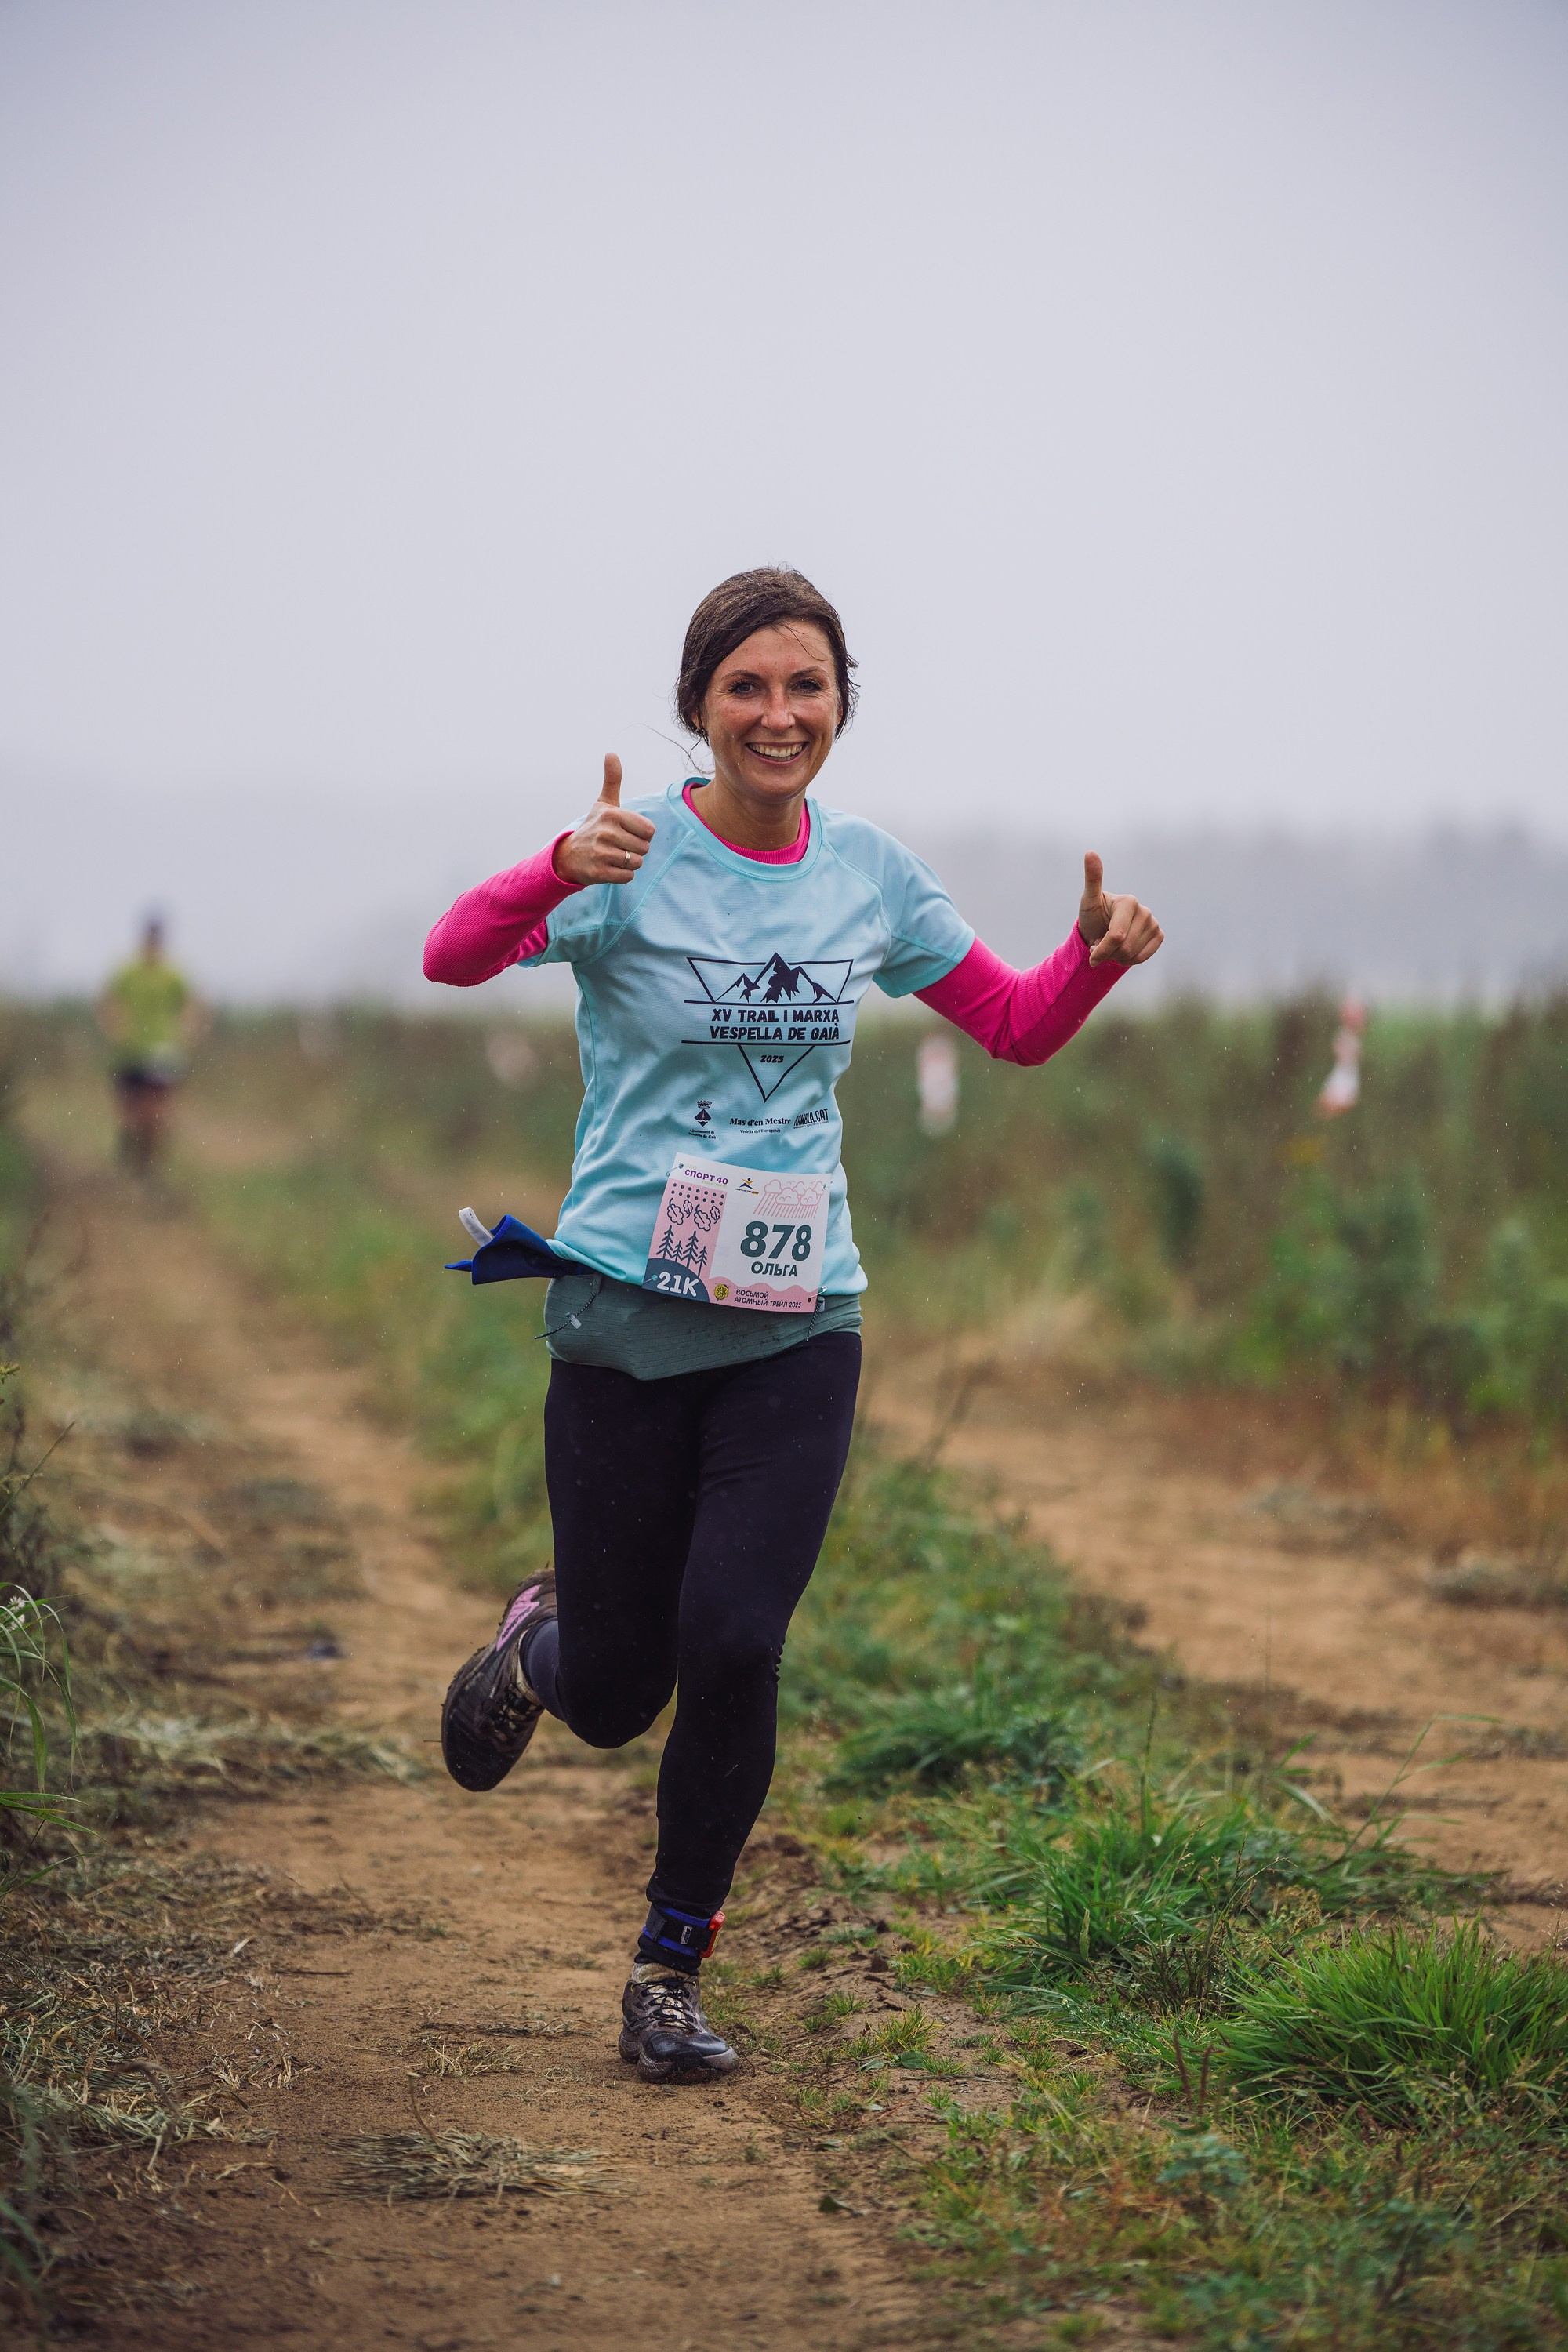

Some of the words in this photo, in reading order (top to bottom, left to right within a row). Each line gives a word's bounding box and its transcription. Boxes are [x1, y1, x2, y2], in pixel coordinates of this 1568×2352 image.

[711, 1008, 732, 1022] XV
[737, 1009, 779, 1023] TRAIL
[783, 1009, 788, 1022] I
[792, 1009, 839, 1022] MARXA
[710, 1025, 782, 1040] VESPELLA
[787, 1027, 807, 1040] DE
[810, 1023, 840, 1040] GAIÀ
[760, 1054, 784, 1063] 2025
[793, 1108, 829, 1127] RAMBLA.CAT
[684, 1169, 715, 1182] СПОРТ
[739, 1221, 812, 1261] 878
[750, 1261, 798, 1277] ОЛЬГА
[734, 1296, 768, 1306] АТОМНЫЙ
[735, 1289, 769, 1299] ВОСЬМОЙ
